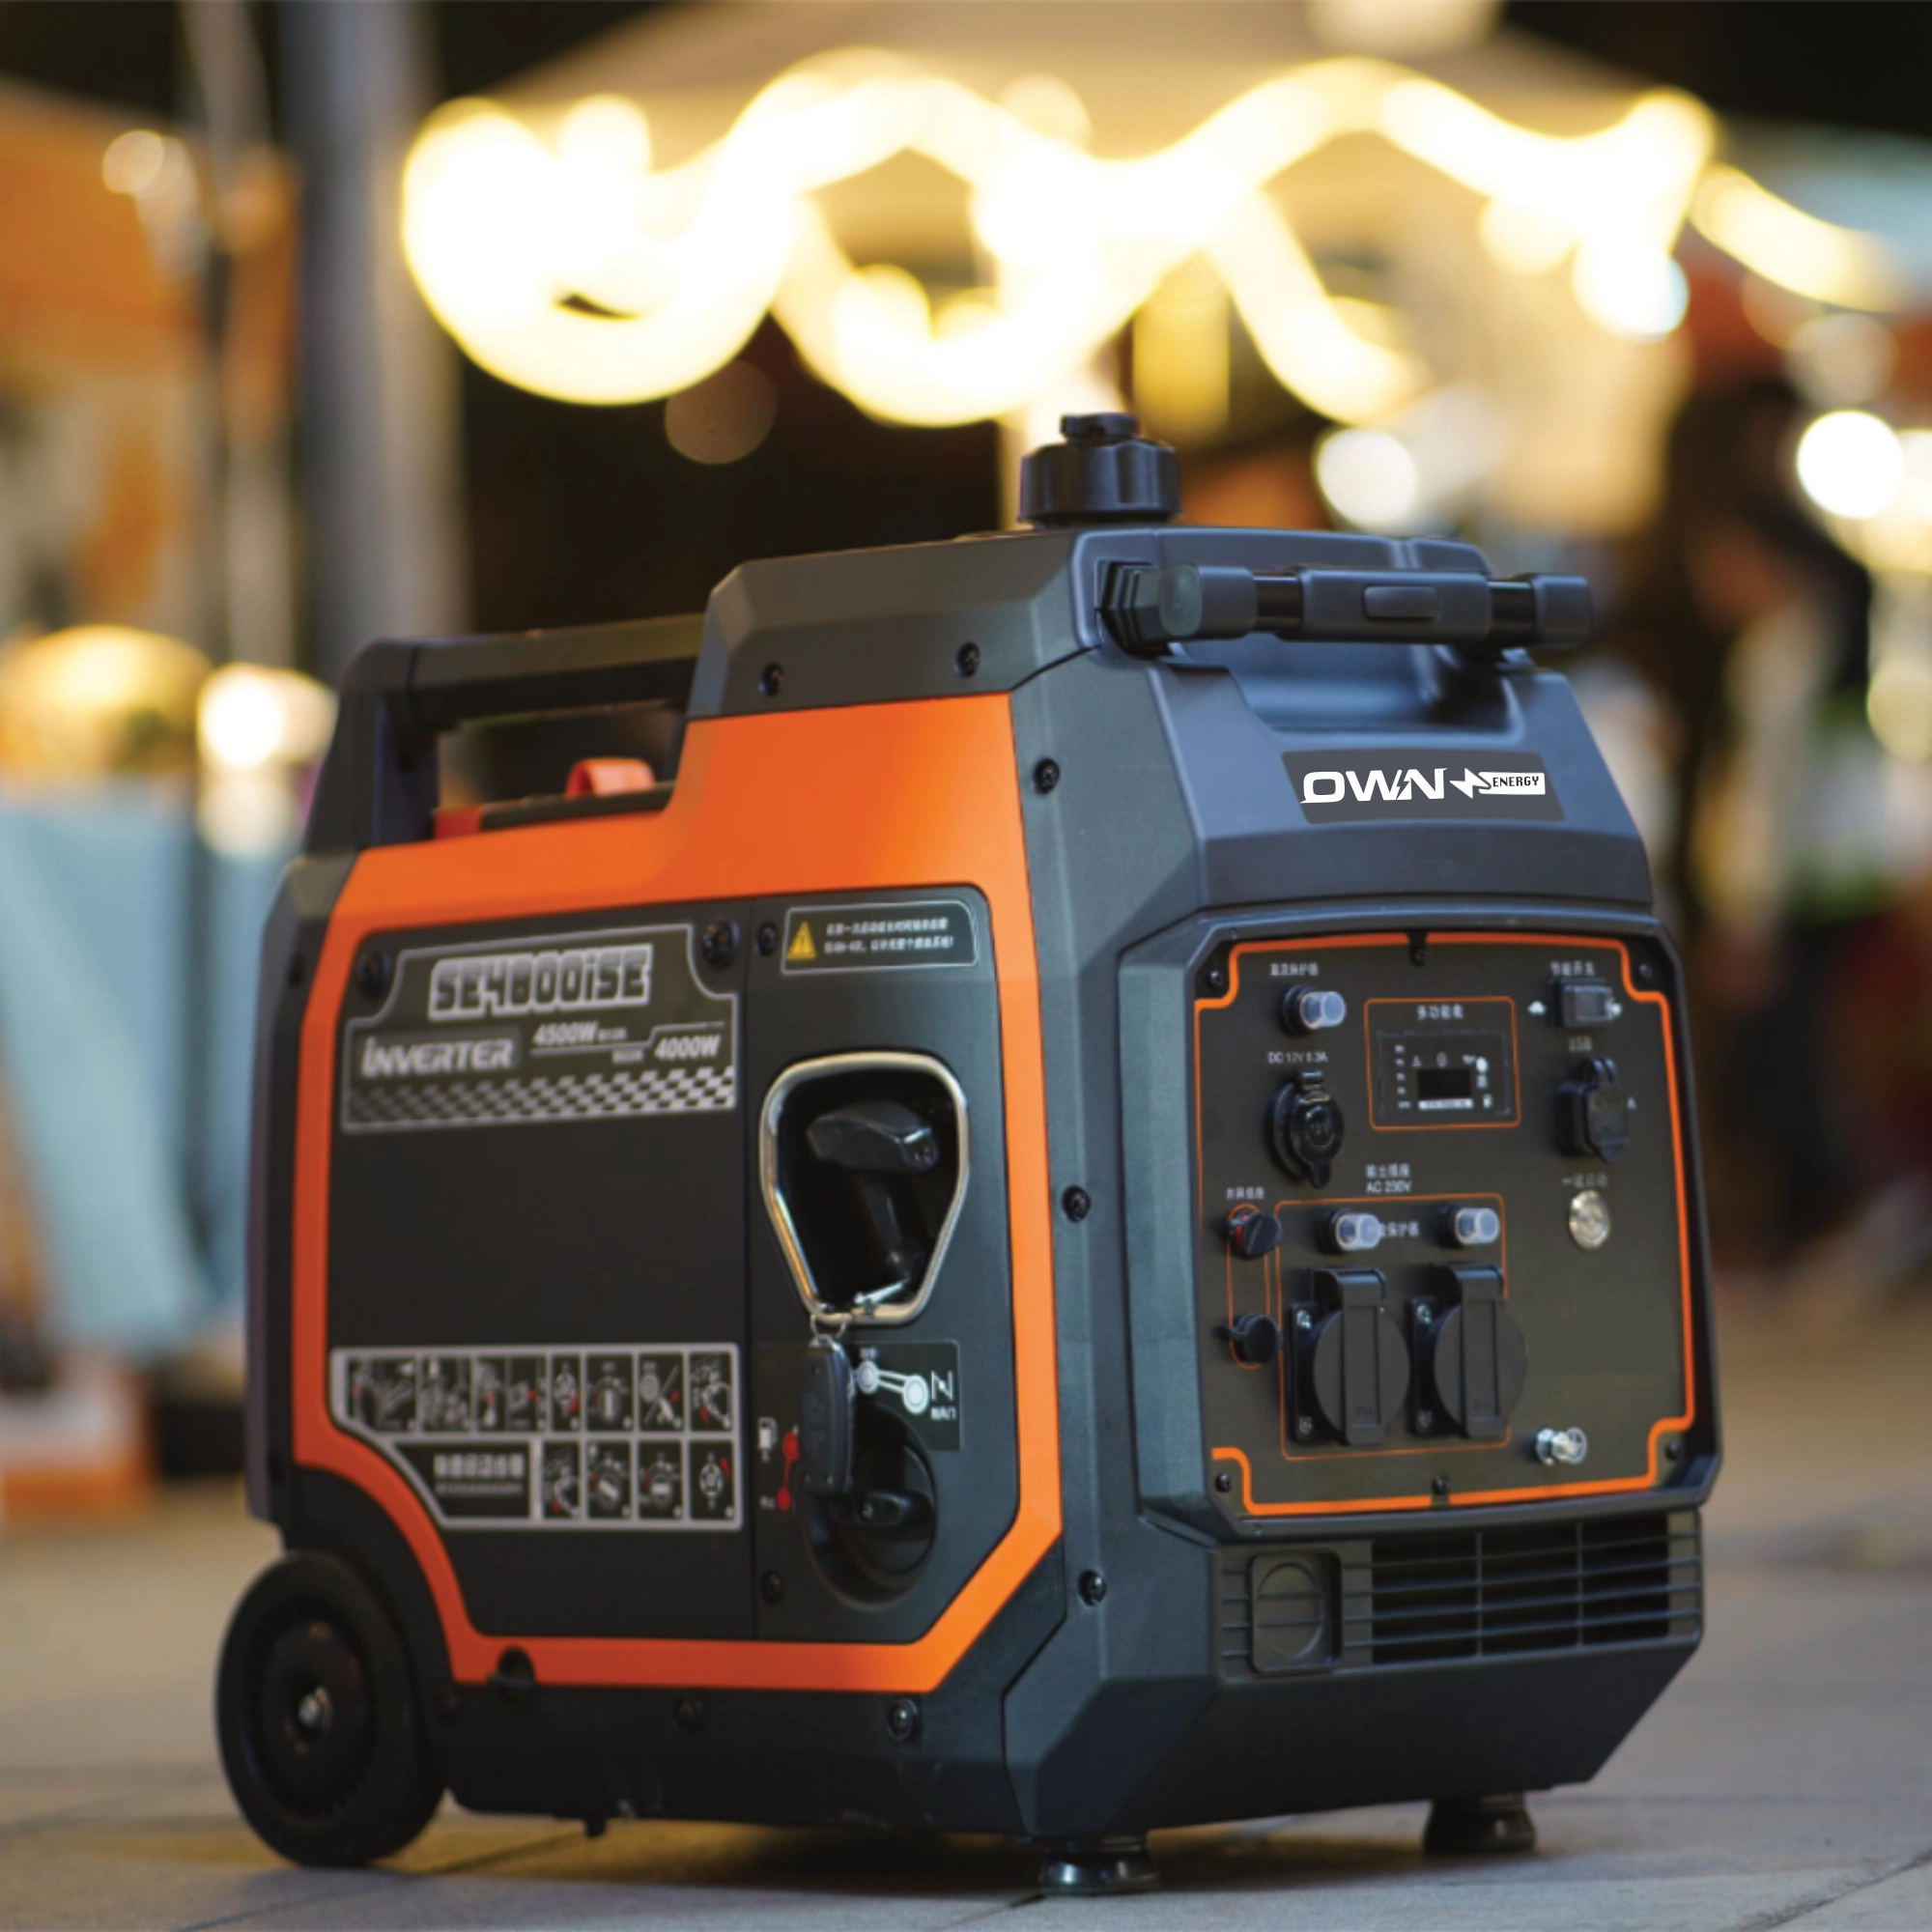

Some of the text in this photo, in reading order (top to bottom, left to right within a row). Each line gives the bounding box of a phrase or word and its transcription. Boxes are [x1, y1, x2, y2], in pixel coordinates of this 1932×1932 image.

[1299, 768, 1540, 803] OWN ENERGY
[654, 1035, 721, 1061] 4000W
[1267, 1051, 1284, 1064] DC
[1367, 1180, 1381, 1193] AC
